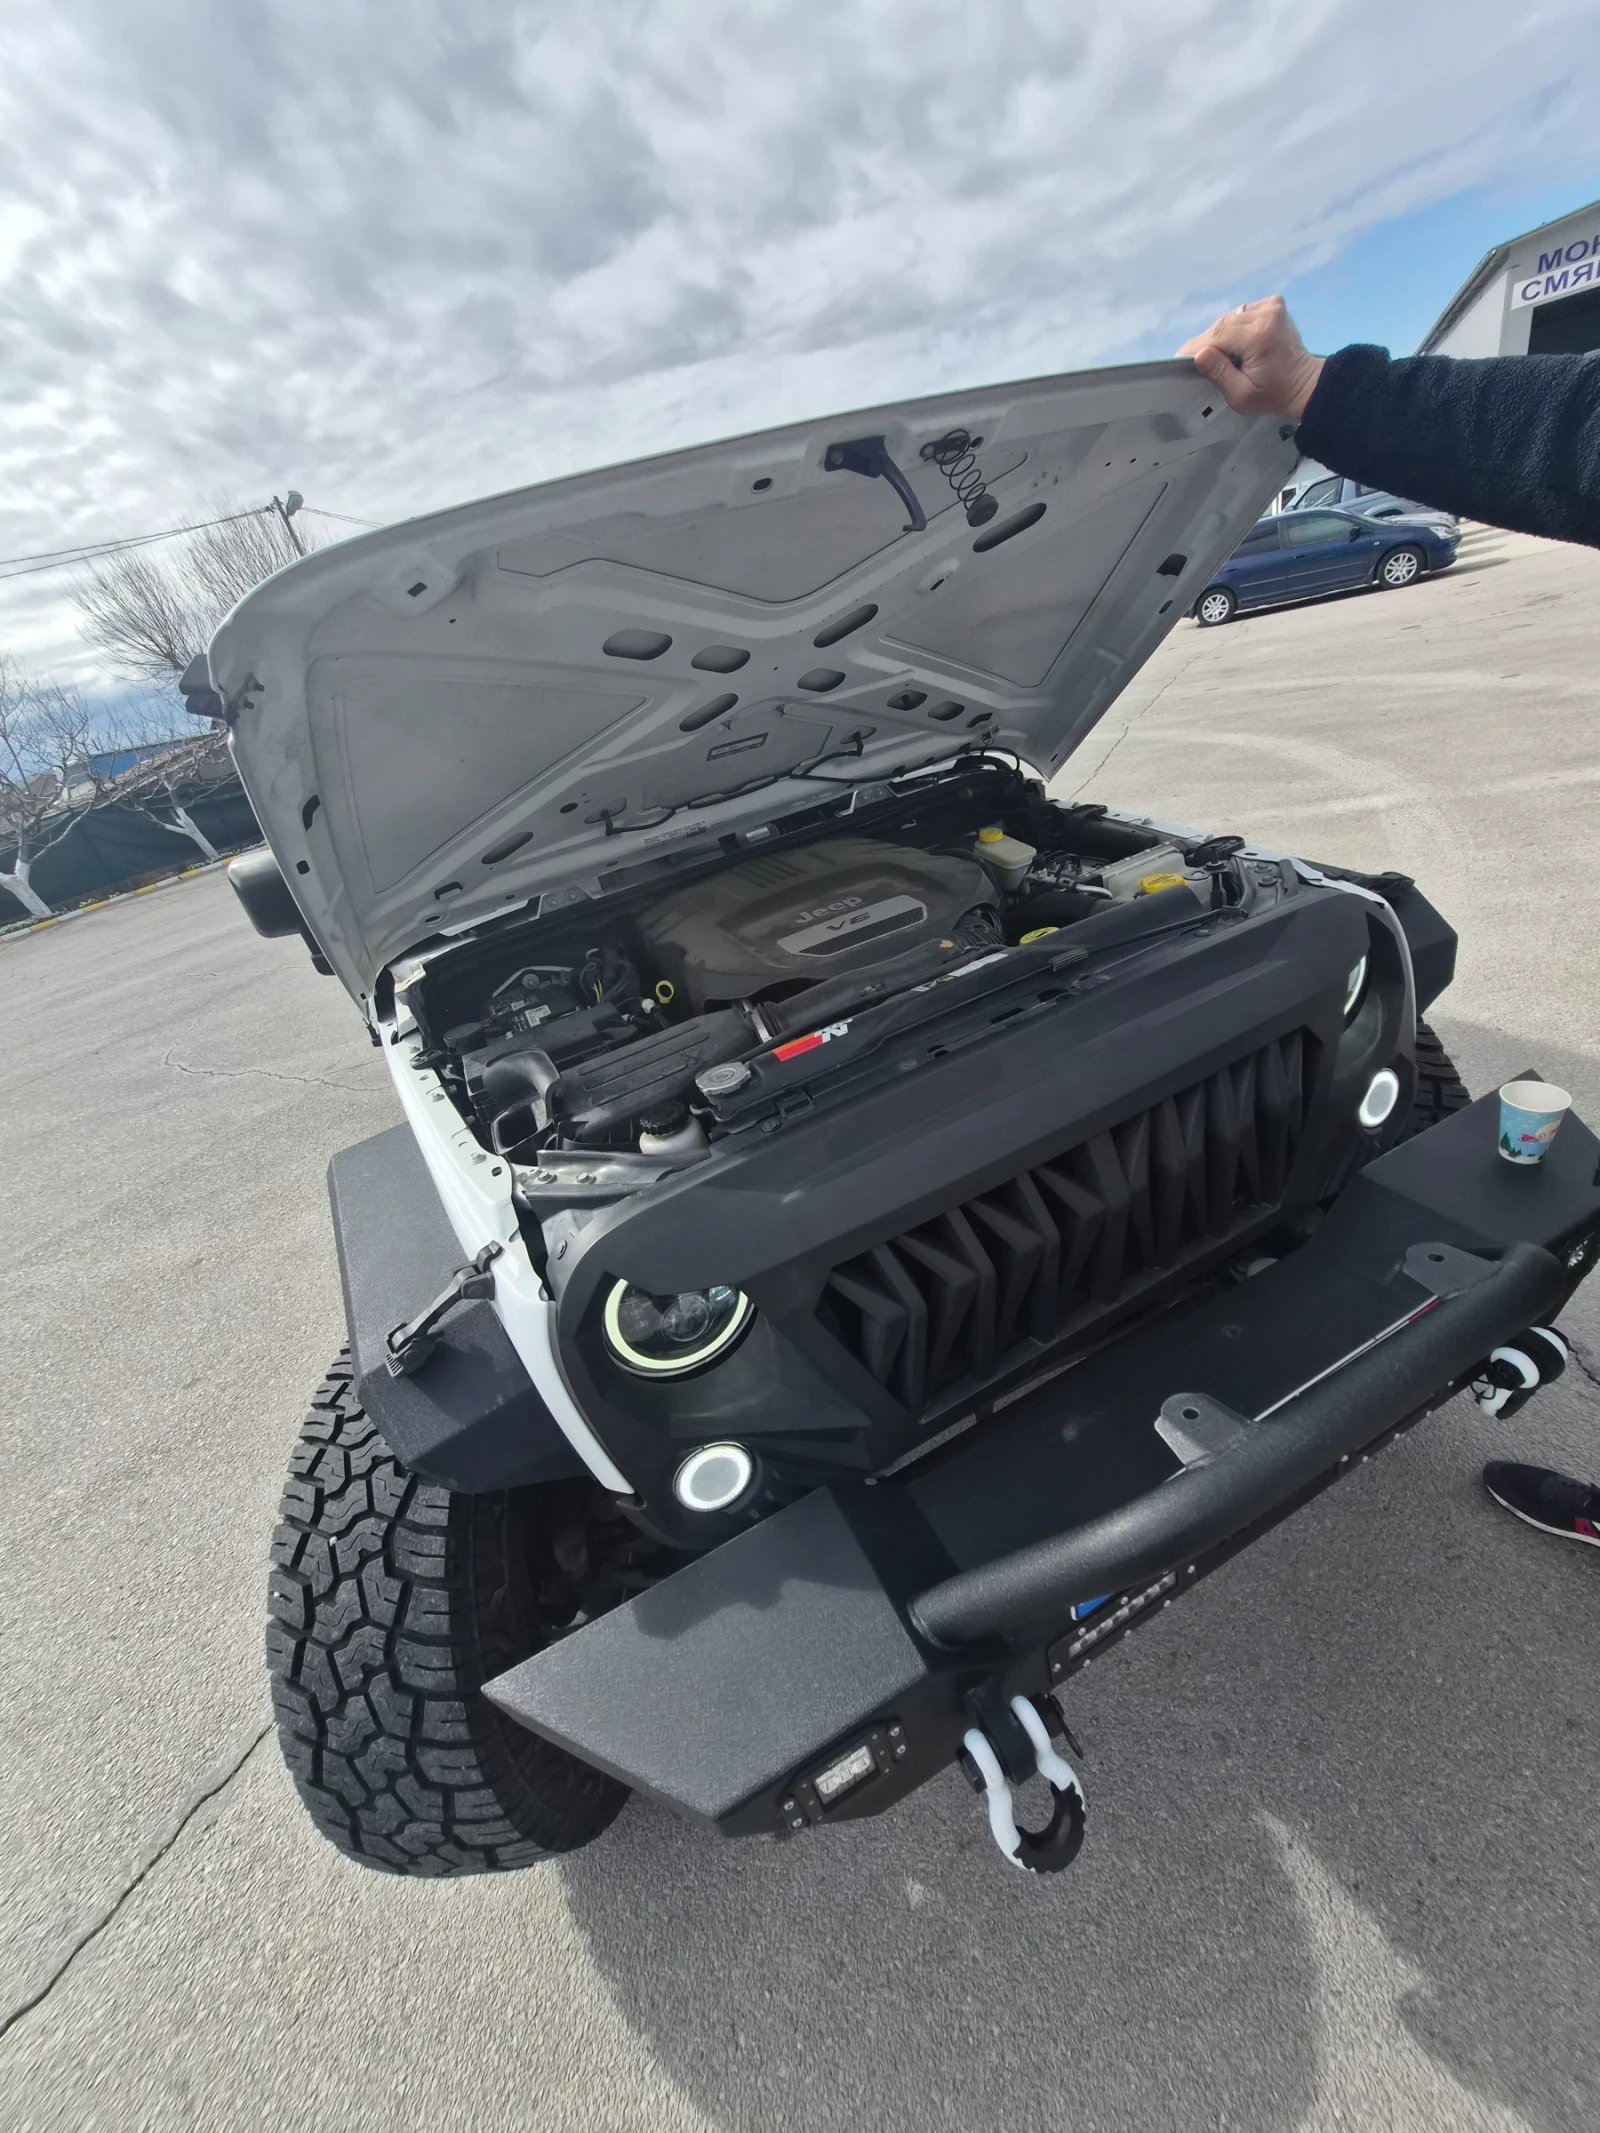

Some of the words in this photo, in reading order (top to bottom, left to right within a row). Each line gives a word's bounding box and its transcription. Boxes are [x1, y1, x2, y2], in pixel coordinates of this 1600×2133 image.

[1521, 260, 1600, 301] СМЯ
[795, 896, 863, 924] Jeep
[826, 912, 871, 931] V6
